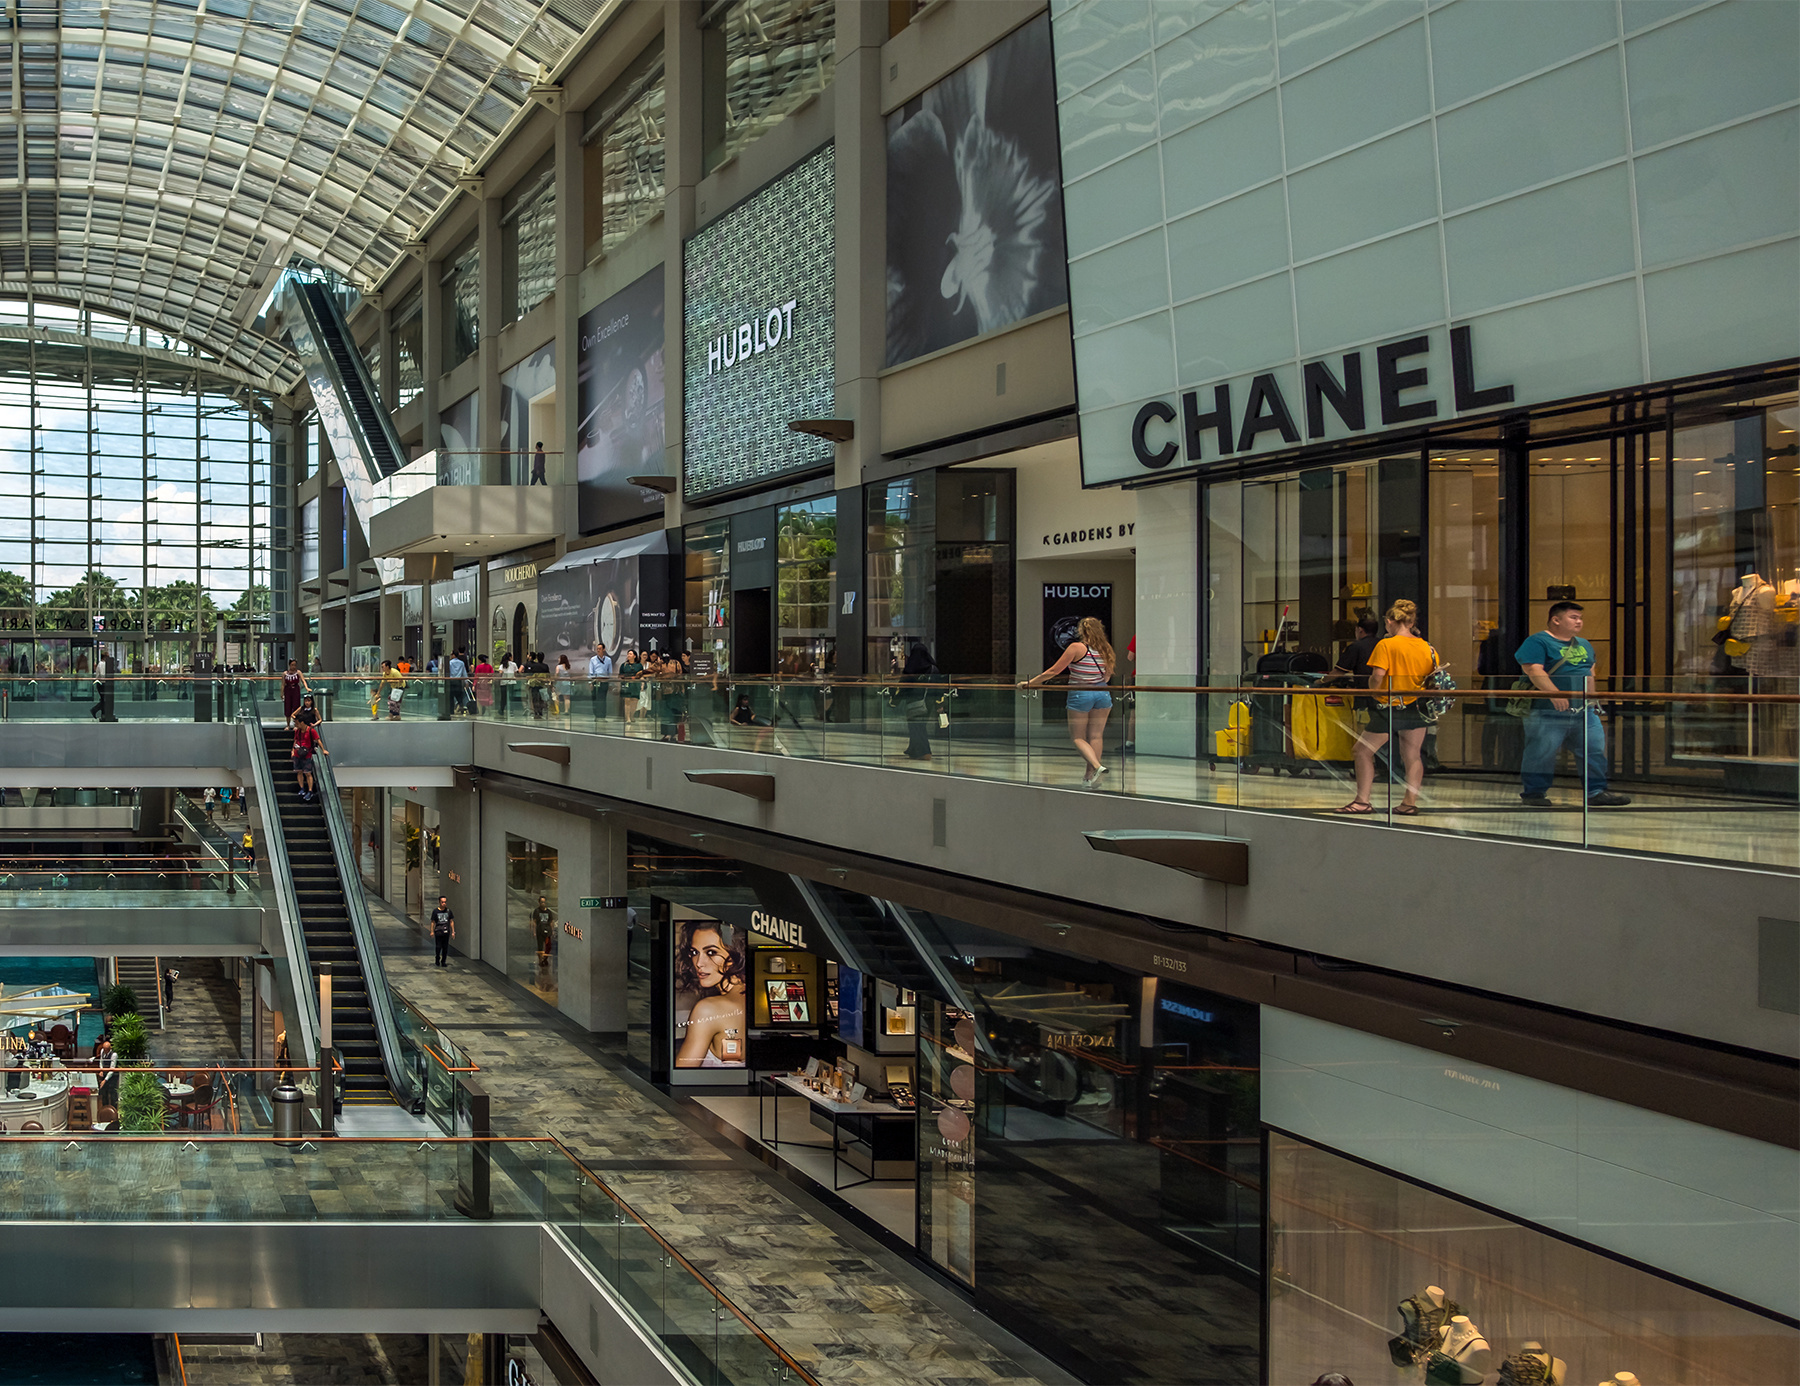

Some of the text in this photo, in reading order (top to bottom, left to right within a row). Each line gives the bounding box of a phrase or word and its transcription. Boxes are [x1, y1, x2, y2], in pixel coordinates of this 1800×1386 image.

[581, 314, 630, 352] Own Excellence
[708, 299, 797, 375] HUBLOT
[1131, 325, 1515, 470] CHANEL
[1053, 522, 1135, 545] GARDENS BY
[504, 563, 538, 583] BOUCHERON
[1044, 586, 1111, 598] HUBLOT
[200, 659, 205, 669] 1
[581, 899, 595, 907] EXIT
[751, 910, 808, 949] CHANEL
[1152, 953, 1188, 973] B1-132/133
